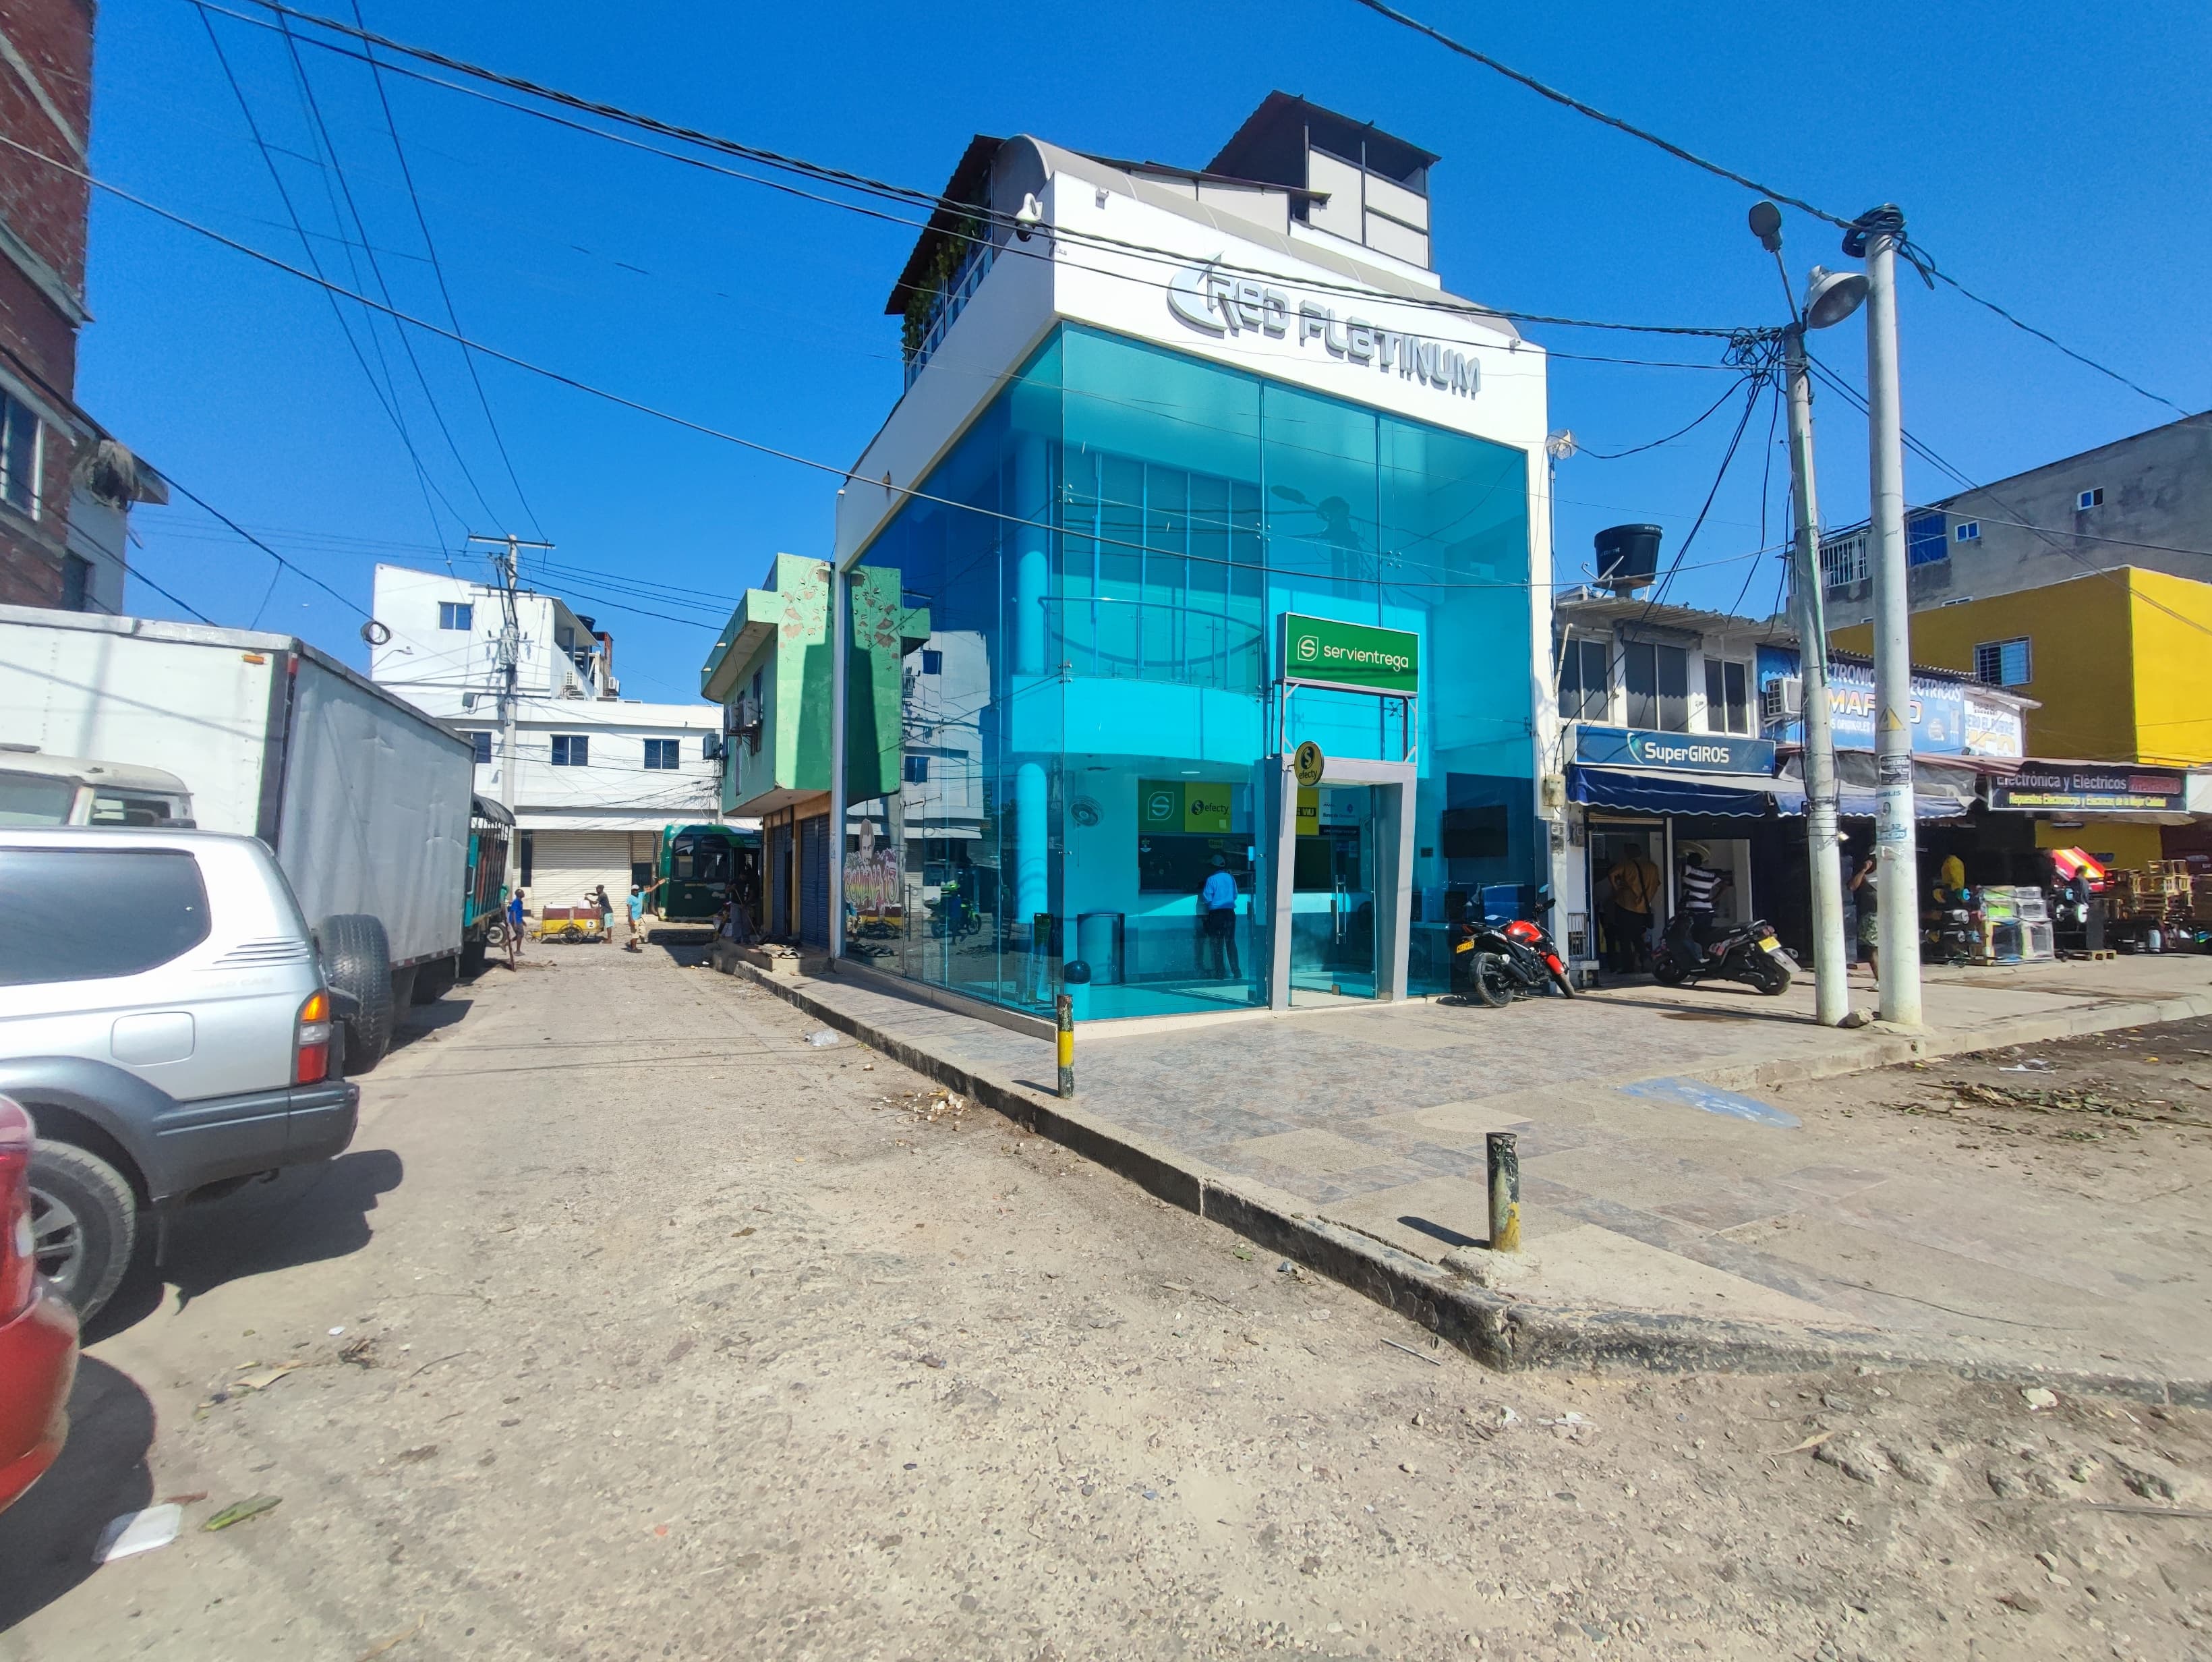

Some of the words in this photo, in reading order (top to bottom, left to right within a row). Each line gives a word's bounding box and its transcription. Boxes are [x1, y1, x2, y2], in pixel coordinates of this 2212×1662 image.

[1324, 645, 1409, 672] servientrega
[1910, 676, 1962, 702] ECTRICOS
[1645, 741, 1730, 764] SuperGIROS
[1299, 770, 1318, 780] efecty
[2064, 776, 2070, 792] y
[1205, 803, 1229, 815] efecty
